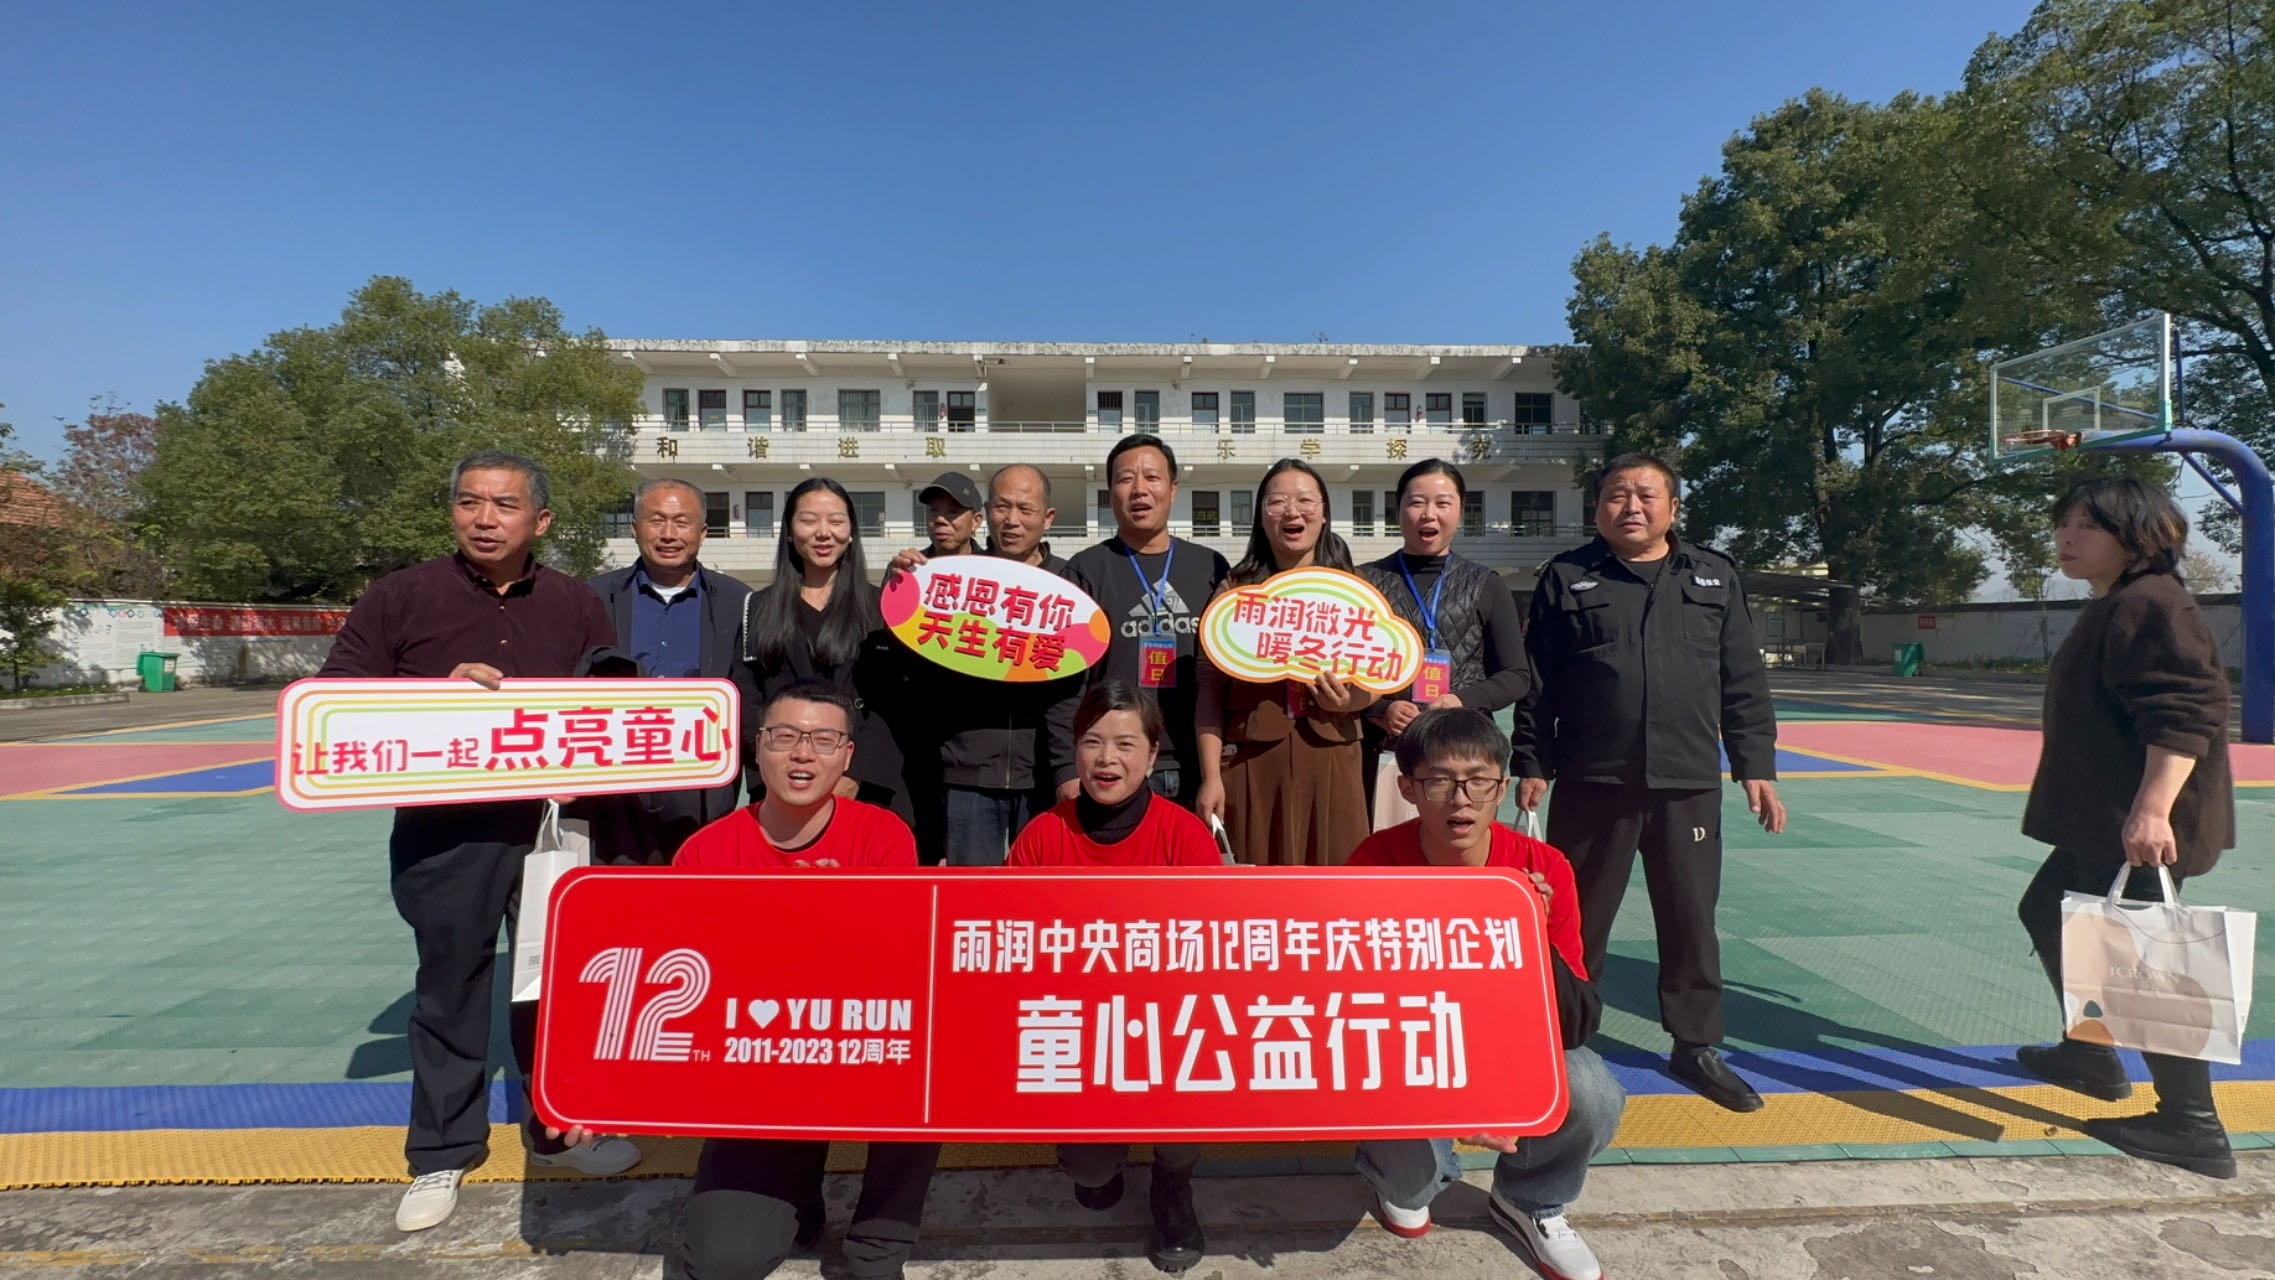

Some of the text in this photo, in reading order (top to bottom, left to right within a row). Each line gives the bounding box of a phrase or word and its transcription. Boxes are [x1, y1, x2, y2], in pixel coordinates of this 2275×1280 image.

[656, 436, 1492, 461] 和谐进取 乐学探究
[923, 573, 1076, 632] 感恩有你
[1120, 612, 1200, 638] addas
[1233, 591, 1376, 642] 雨润微光
[917, 610, 1066, 672] 天生有爱
[1148, 650, 1169, 682] 值日
[1255, 631, 1403, 683] 暖冬行动
[1423, 666, 1443, 698] 值日
[292, 706, 733, 776] 让我们一起点亮童心
[952, 916, 1524, 975] 雨润中央商场12周年庆特别企划
[579, 947, 712, 1062] 12
[787, 998, 832, 1031] YU
[841, 999, 912, 1032] RUN
[724, 1036, 911, 1065] 2011-2023 12周年
[1016, 990, 1468, 1093] 童心公益行动
